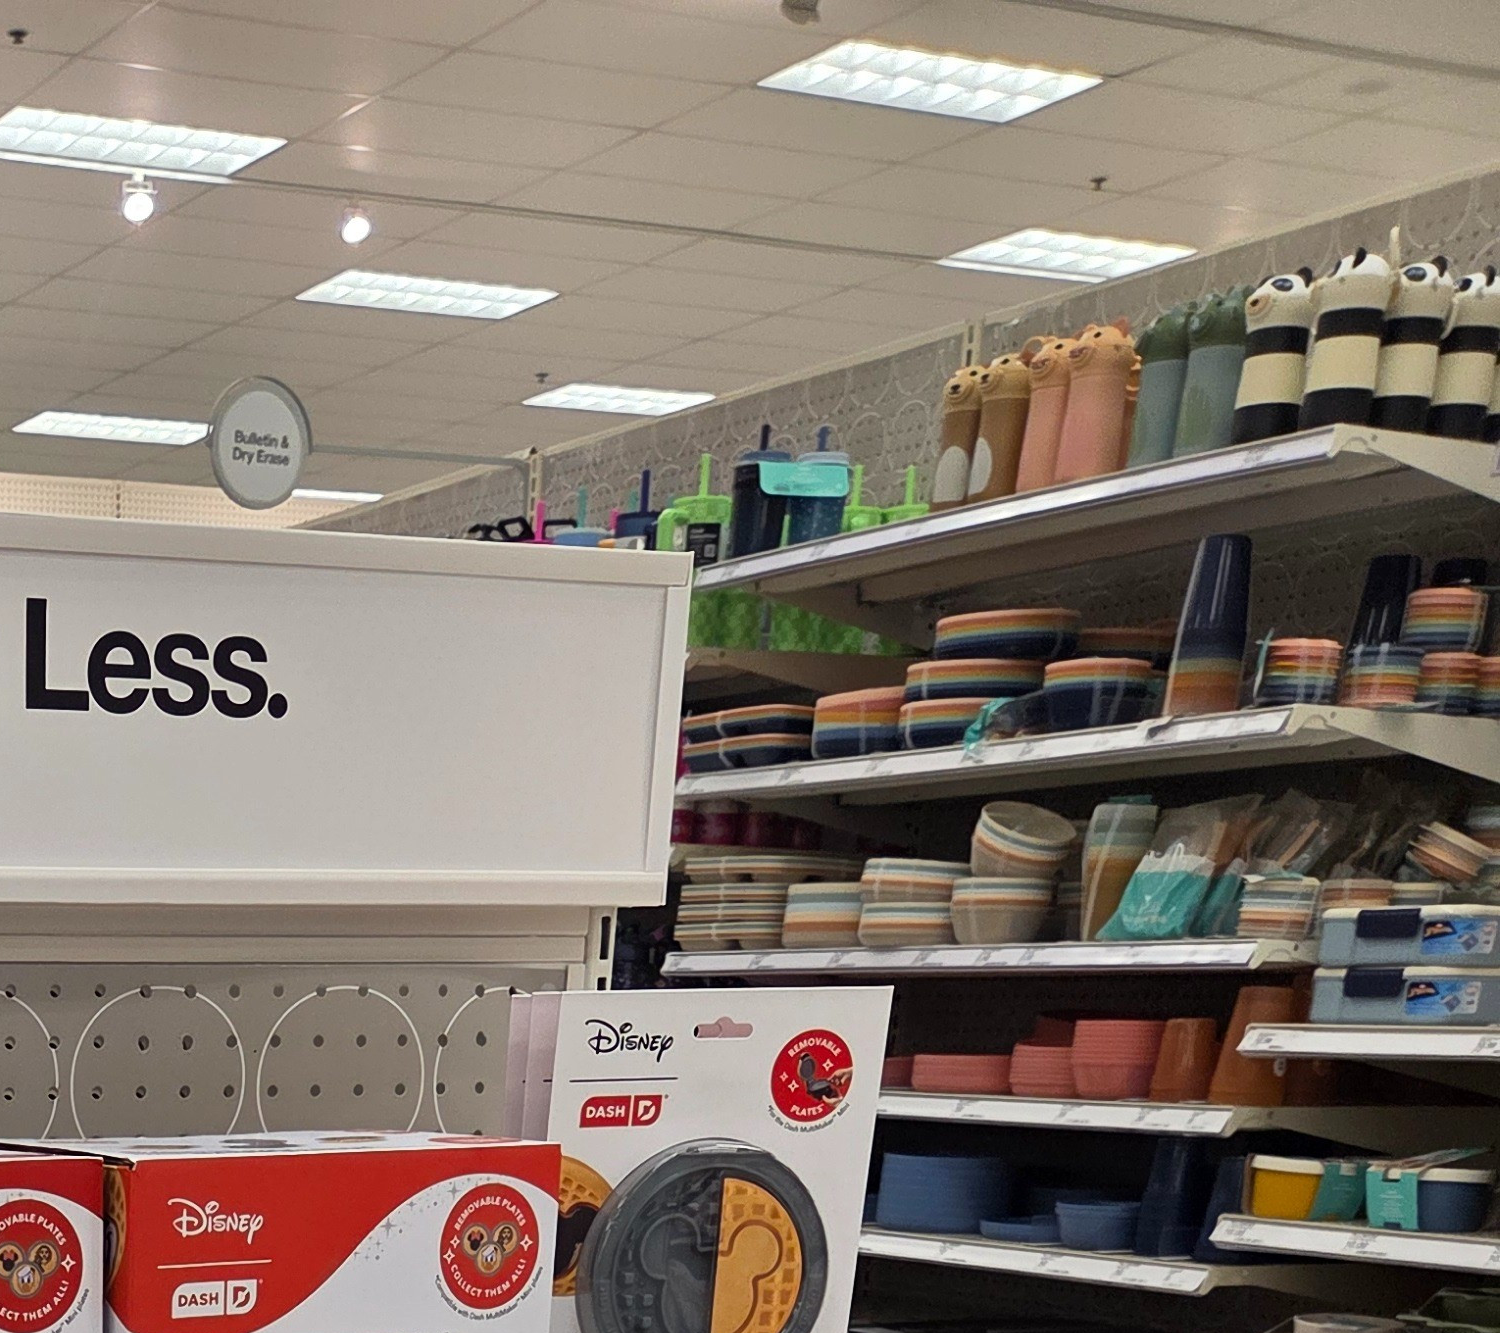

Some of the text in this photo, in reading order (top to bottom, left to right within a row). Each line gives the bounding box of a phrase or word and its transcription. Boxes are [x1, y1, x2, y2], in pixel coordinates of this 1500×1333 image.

[234, 429, 289, 450] Bulletin &
[233, 447, 289, 466] Dry Erase
[25, 598, 288, 719] Less.
[585, 1019, 673, 1062] Disney
[787, 1038, 841, 1058] REMOVABLE
[586, 1106, 626, 1118] DASH
[37, 1213, 67, 1246] PLATES
[168, 1198, 264, 1244] Disney
[22, 1306, 52, 1322] THEM
[54, 1280, 69, 1304] ALL!
[178, 1291, 219, 1307] DASH
